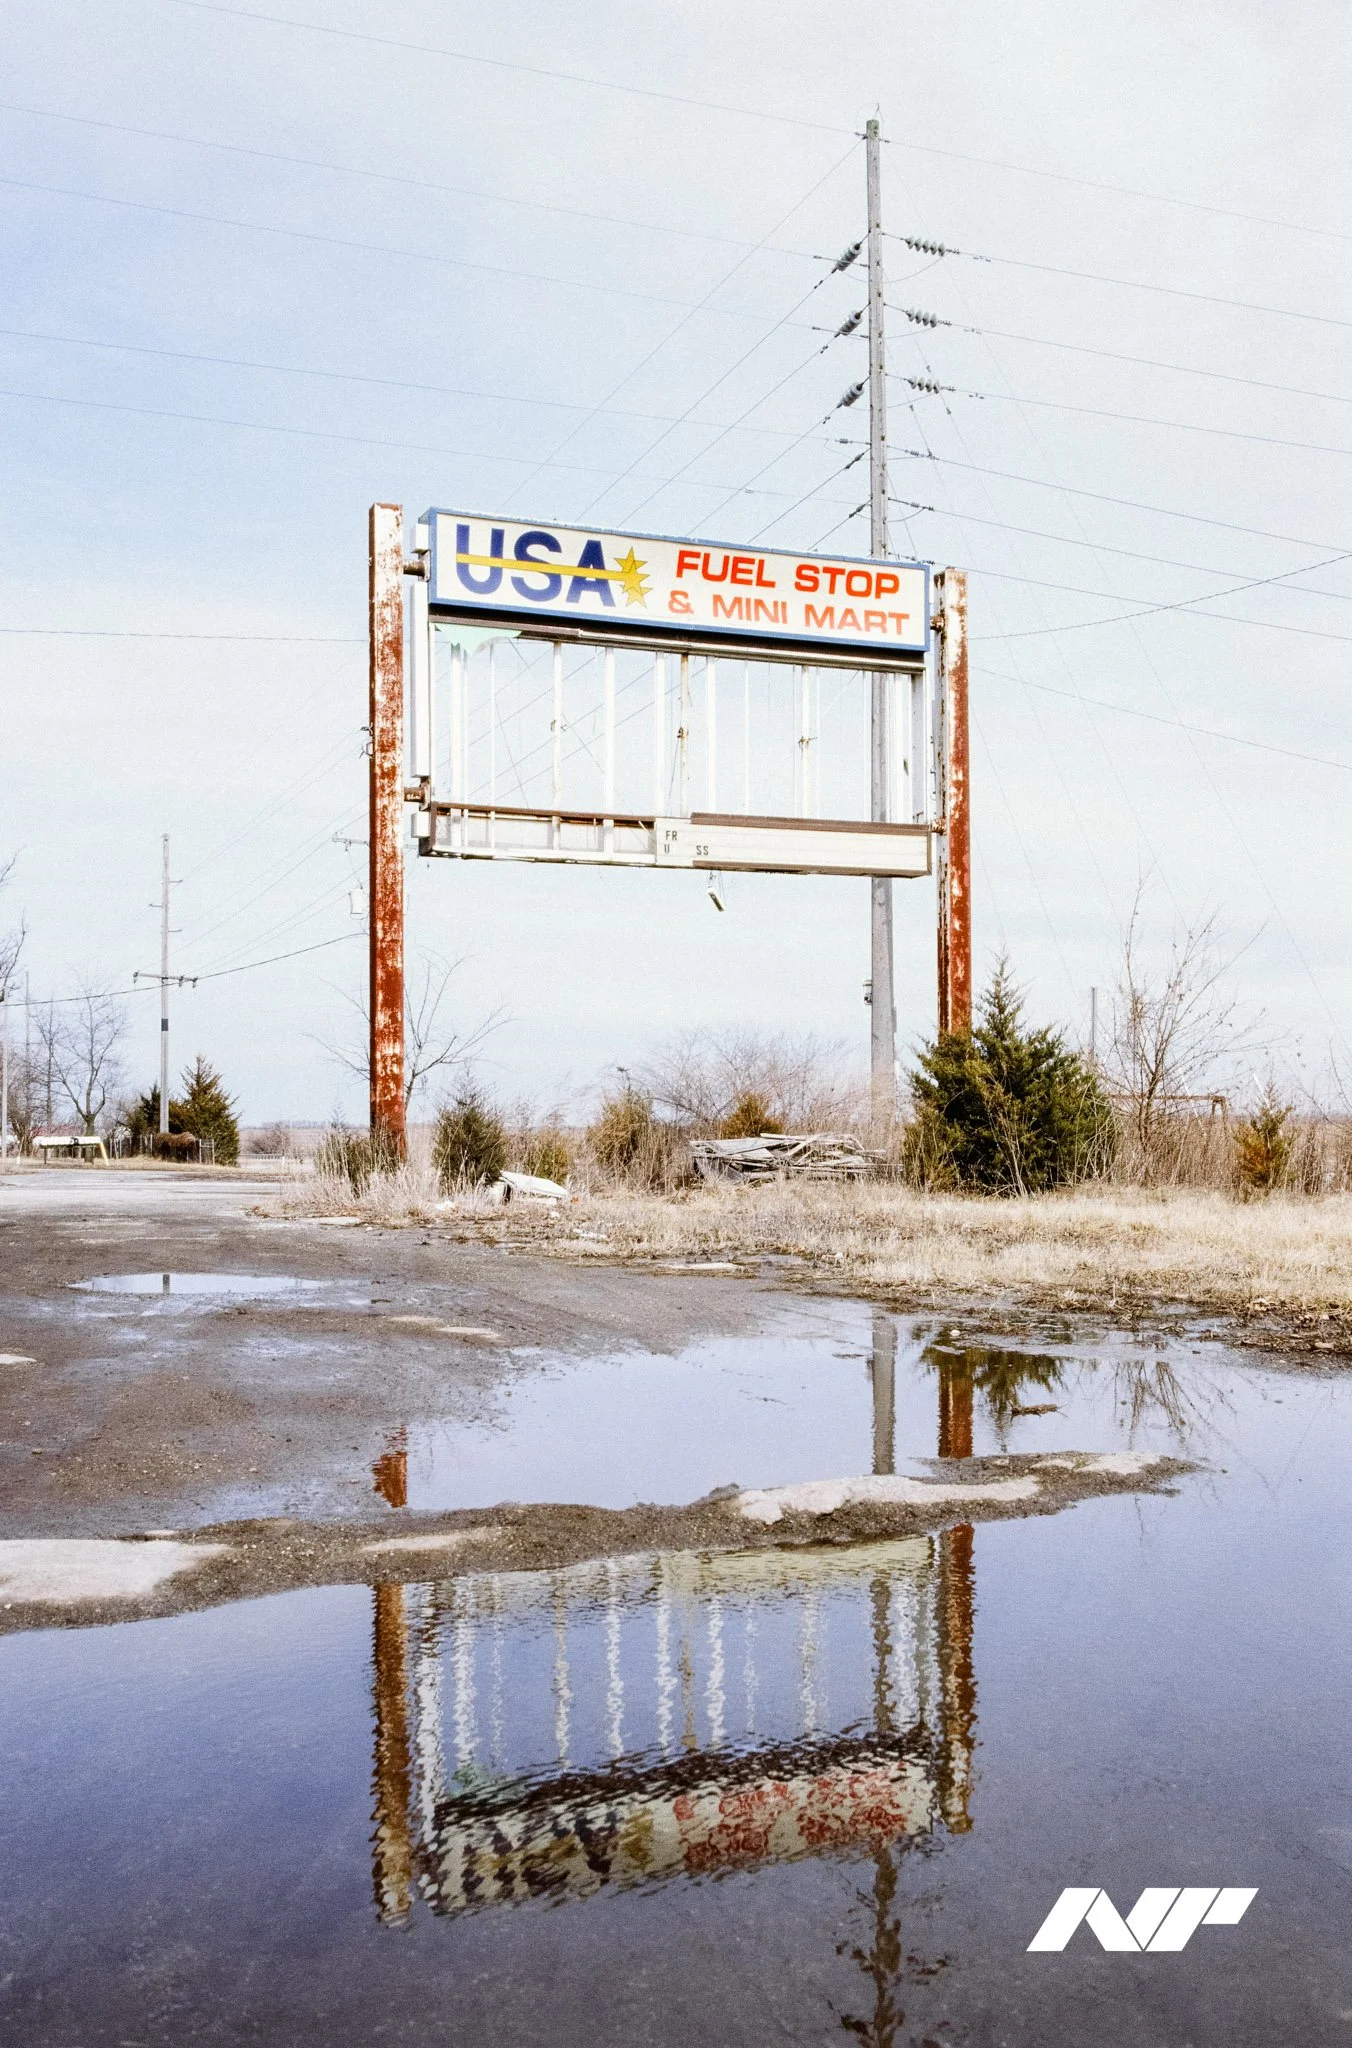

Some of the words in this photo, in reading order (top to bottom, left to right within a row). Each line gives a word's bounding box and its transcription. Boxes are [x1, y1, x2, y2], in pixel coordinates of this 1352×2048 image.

[457, 524, 614, 606] USA
[676, 550, 776, 588] FUEL
[794, 564, 900, 599] STOP
[668, 590, 693, 614] &
[713, 595, 788, 625] MINI
[804, 605, 910, 636] MART
[665, 830, 678, 841] FR
[696, 845, 709, 855] SS
